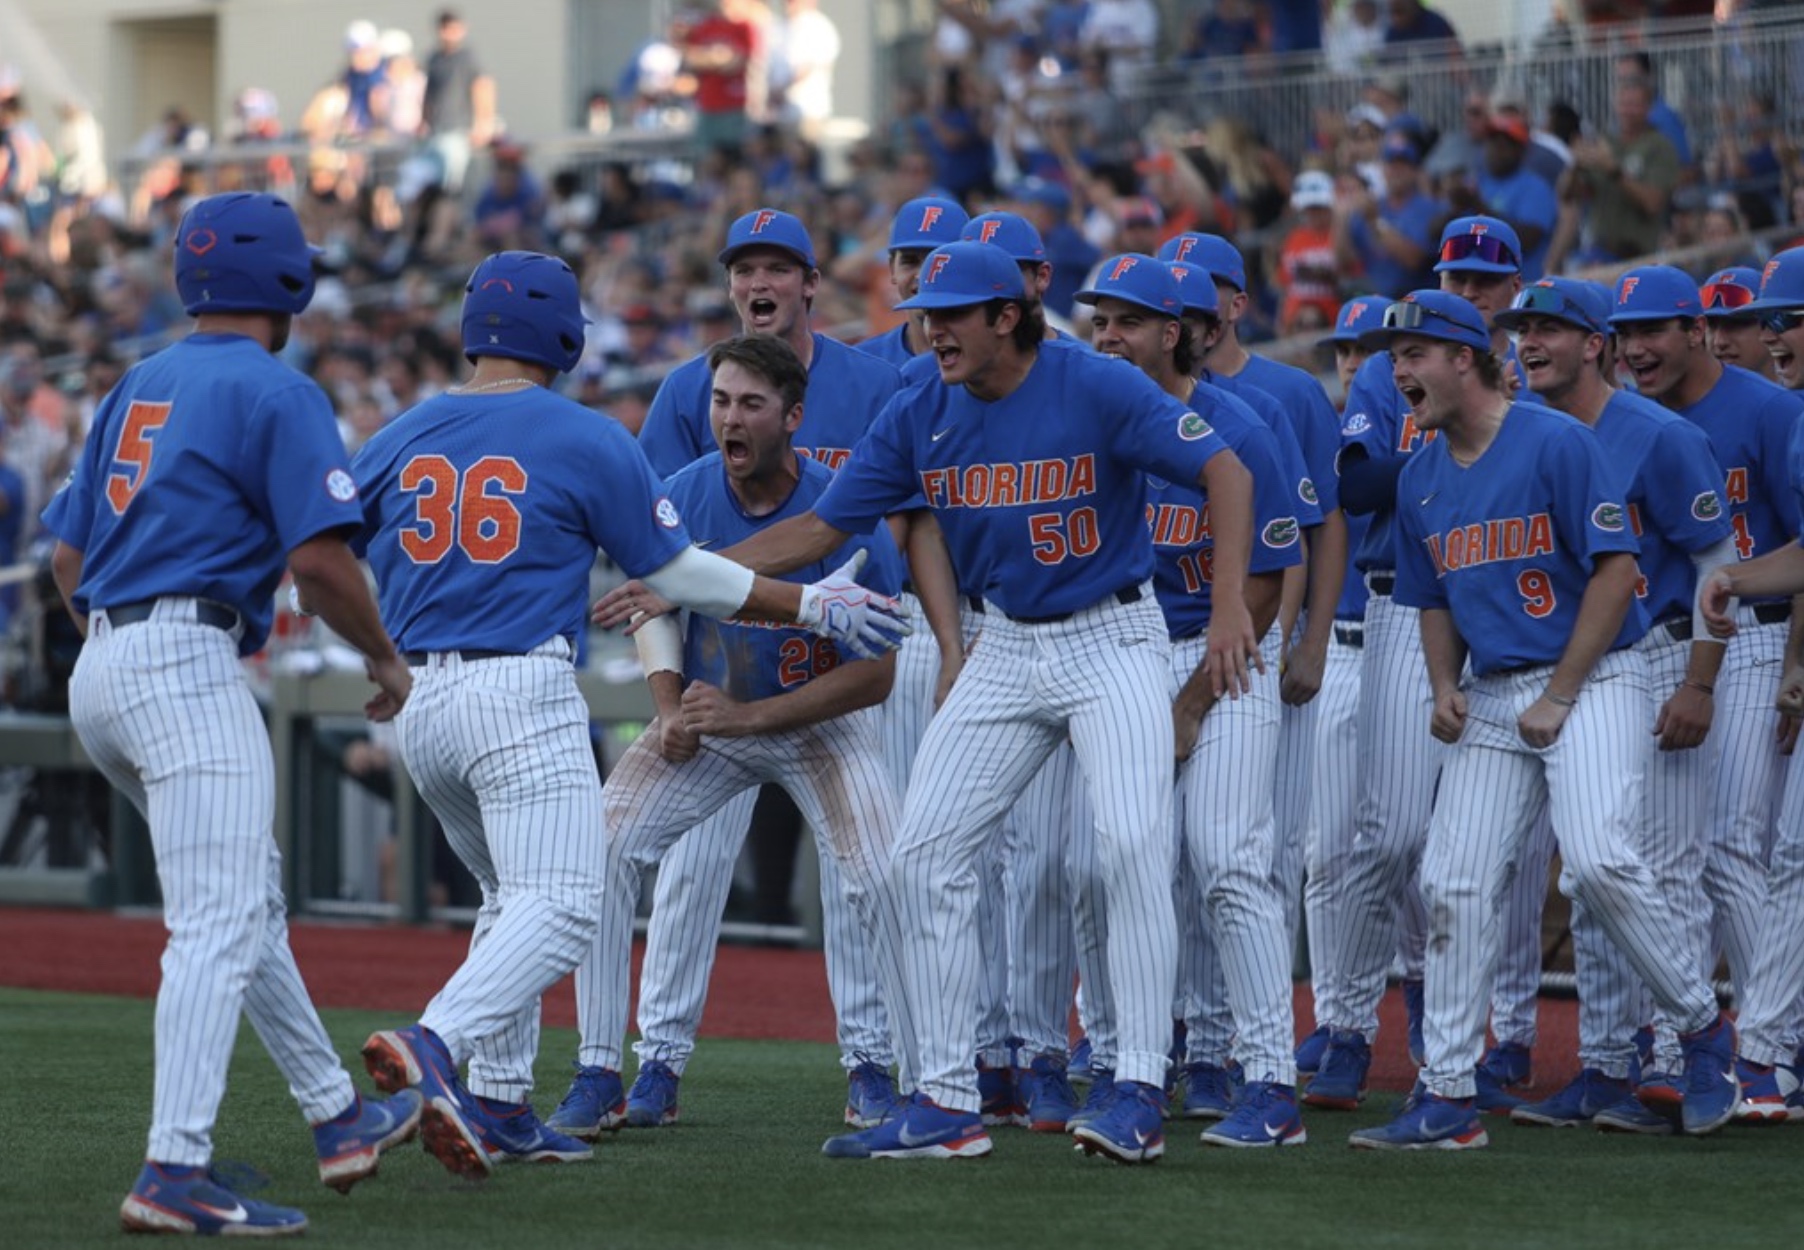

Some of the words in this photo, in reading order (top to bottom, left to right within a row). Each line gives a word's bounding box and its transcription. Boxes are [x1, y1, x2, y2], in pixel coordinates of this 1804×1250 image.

[750, 210, 777, 235] F
[917, 206, 943, 232] F
[979, 220, 1001, 244] F
[1174, 237, 1198, 262] F
[924, 253, 951, 284] F
[1108, 257, 1139, 281] F
[1618, 276, 1641, 305] F
[1345, 303, 1368, 327] F
[105, 400, 174, 517] 5
[919, 453, 1097, 509] FLORIDA
[400, 454, 528, 564] 36
[1028, 506, 1102, 567] 50
[1516, 568, 1557, 619] 9
[778, 636, 840, 687] 26
